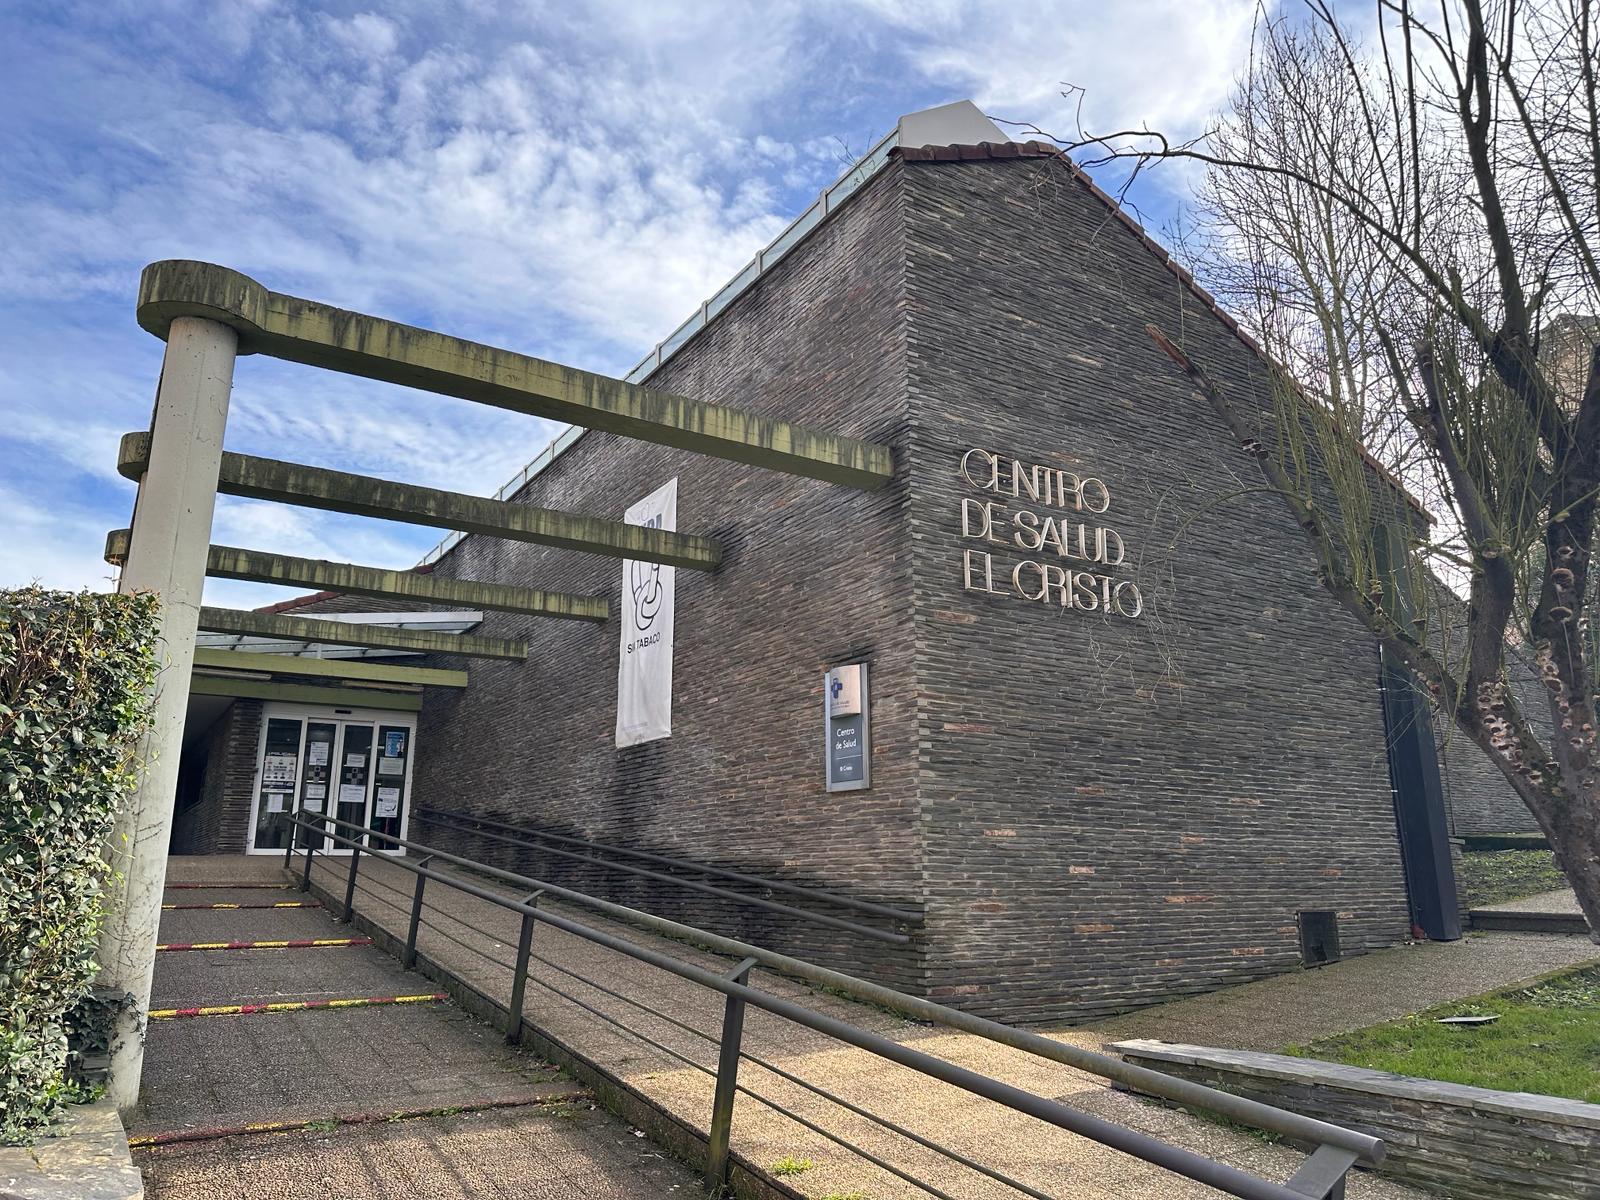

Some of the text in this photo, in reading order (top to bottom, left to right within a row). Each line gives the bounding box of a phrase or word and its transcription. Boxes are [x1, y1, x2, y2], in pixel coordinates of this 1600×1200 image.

[961, 448, 1110, 513] CENTRO
[962, 498, 1125, 565] DE SALUD
[964, 550, 1143, 618] EL CRISTO
[637, 631, 660, 649] TABACO
[835, 738, 856, 750] de Salud
[836, 728, 855, 737] Centro
